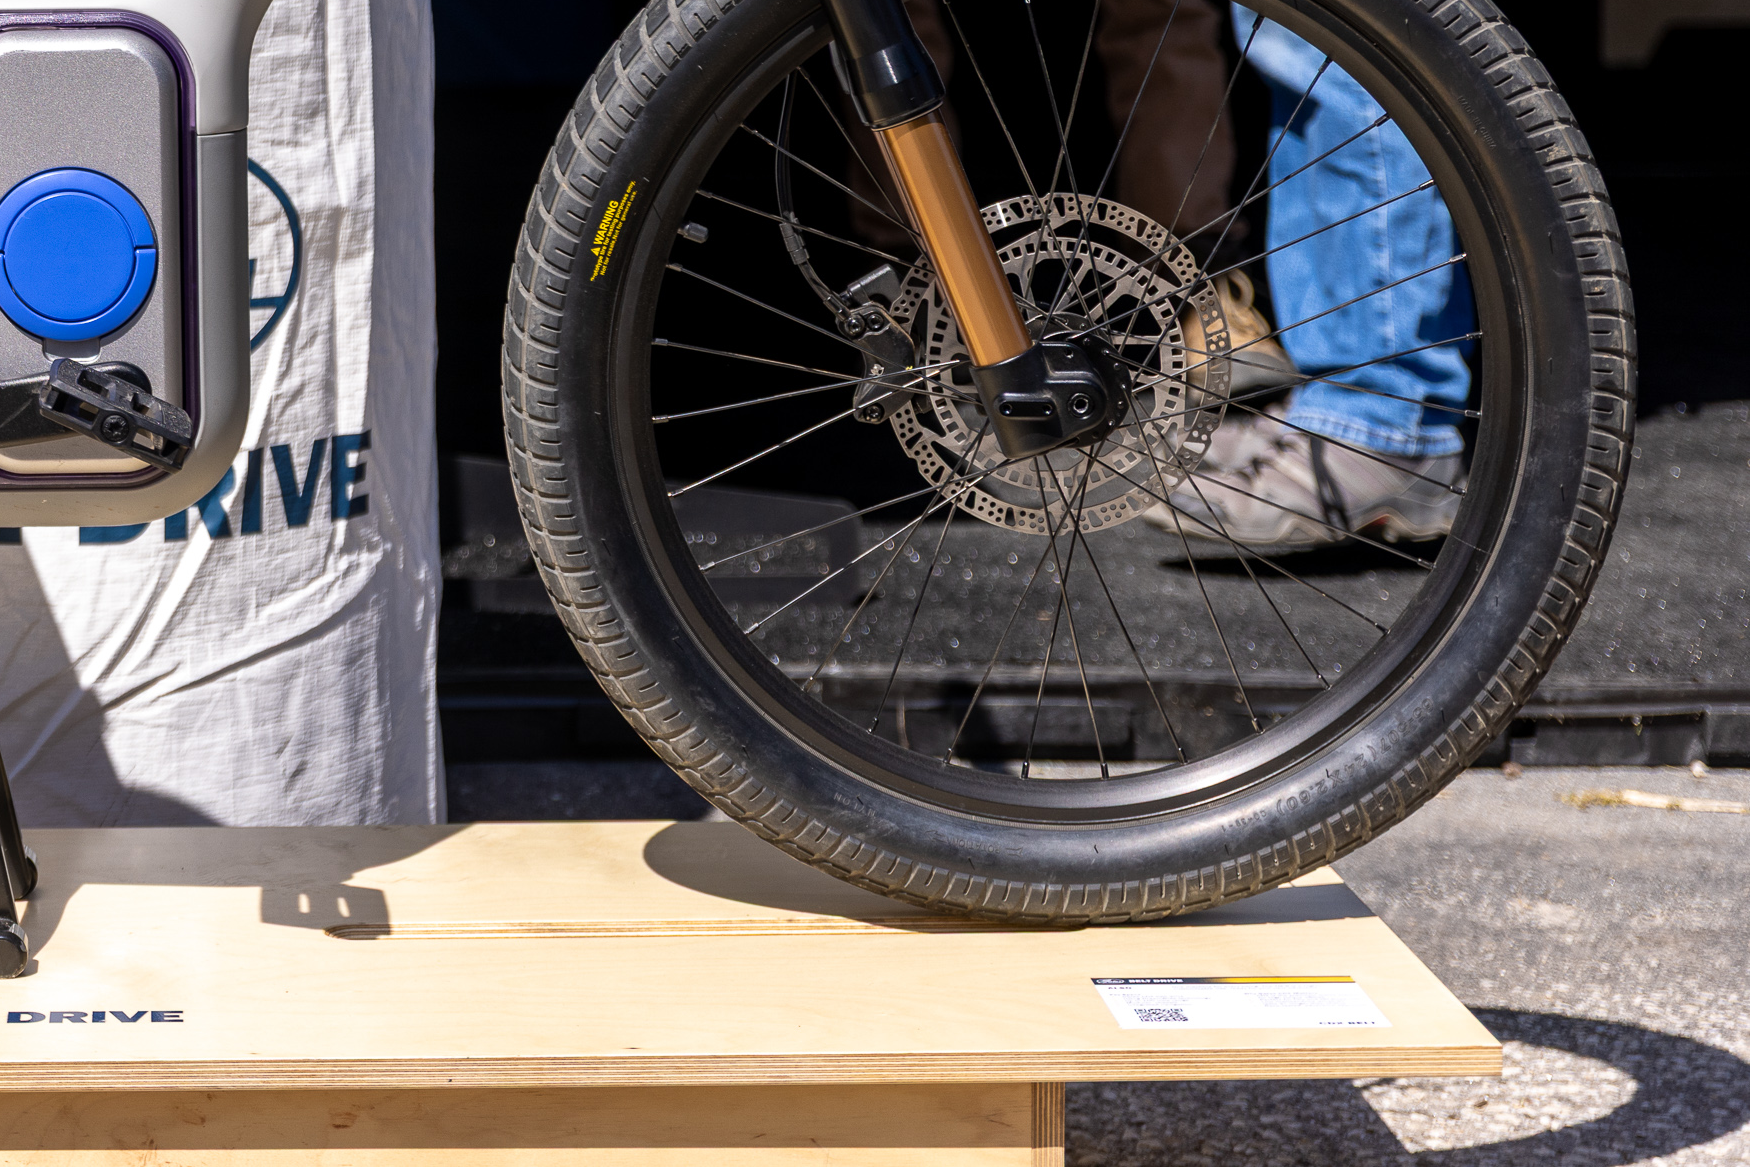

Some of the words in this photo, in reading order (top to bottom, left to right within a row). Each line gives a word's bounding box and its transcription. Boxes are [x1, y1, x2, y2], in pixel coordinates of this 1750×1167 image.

[593, 200, 619, 245] WARNING
[79, 430, 372, 545] RIVE
[6, 1010, 184, 1023] DRIVE
